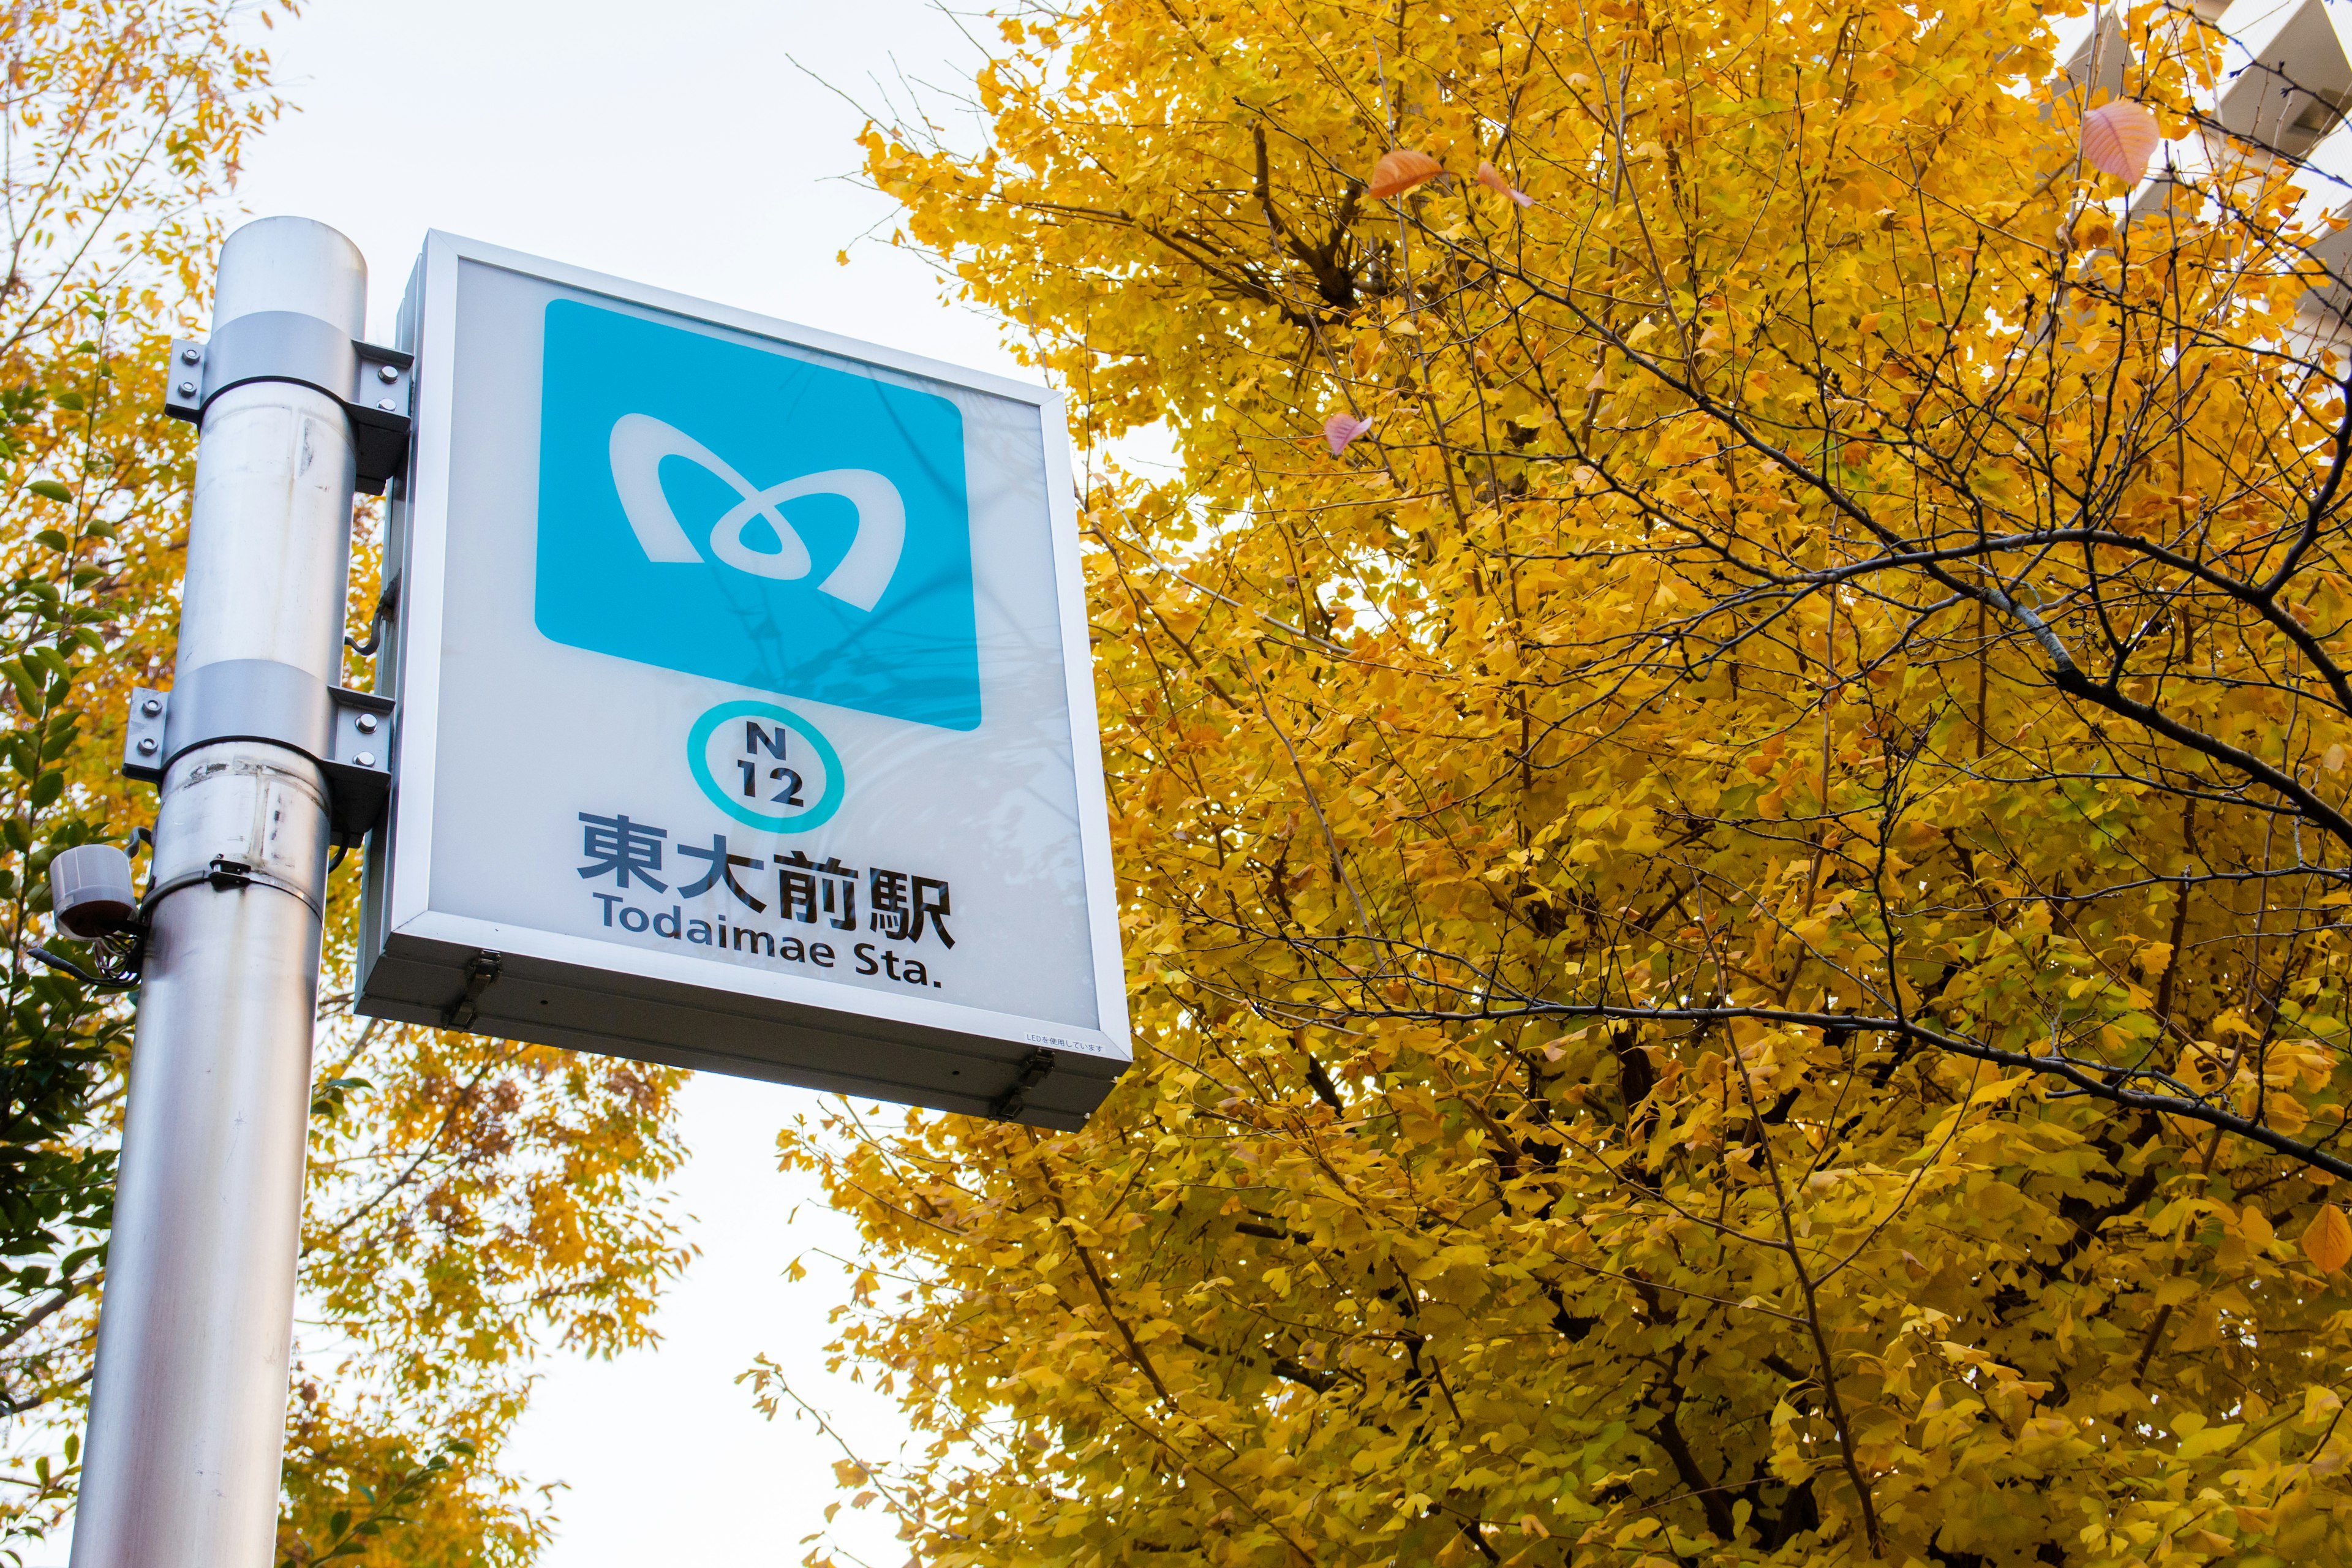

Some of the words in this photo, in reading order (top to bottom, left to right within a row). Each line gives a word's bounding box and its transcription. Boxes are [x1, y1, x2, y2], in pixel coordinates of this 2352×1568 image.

[746, 721, 786, 761] N
[737, 759, 804, 807] 12
[576, 812, 956, 950] 東大前駅
[592, 892, 835, 968] Todaimae
[853, 943, 942, 989] Sta.
[1027, 1033, 1103, 1052] LEDを使用しています
